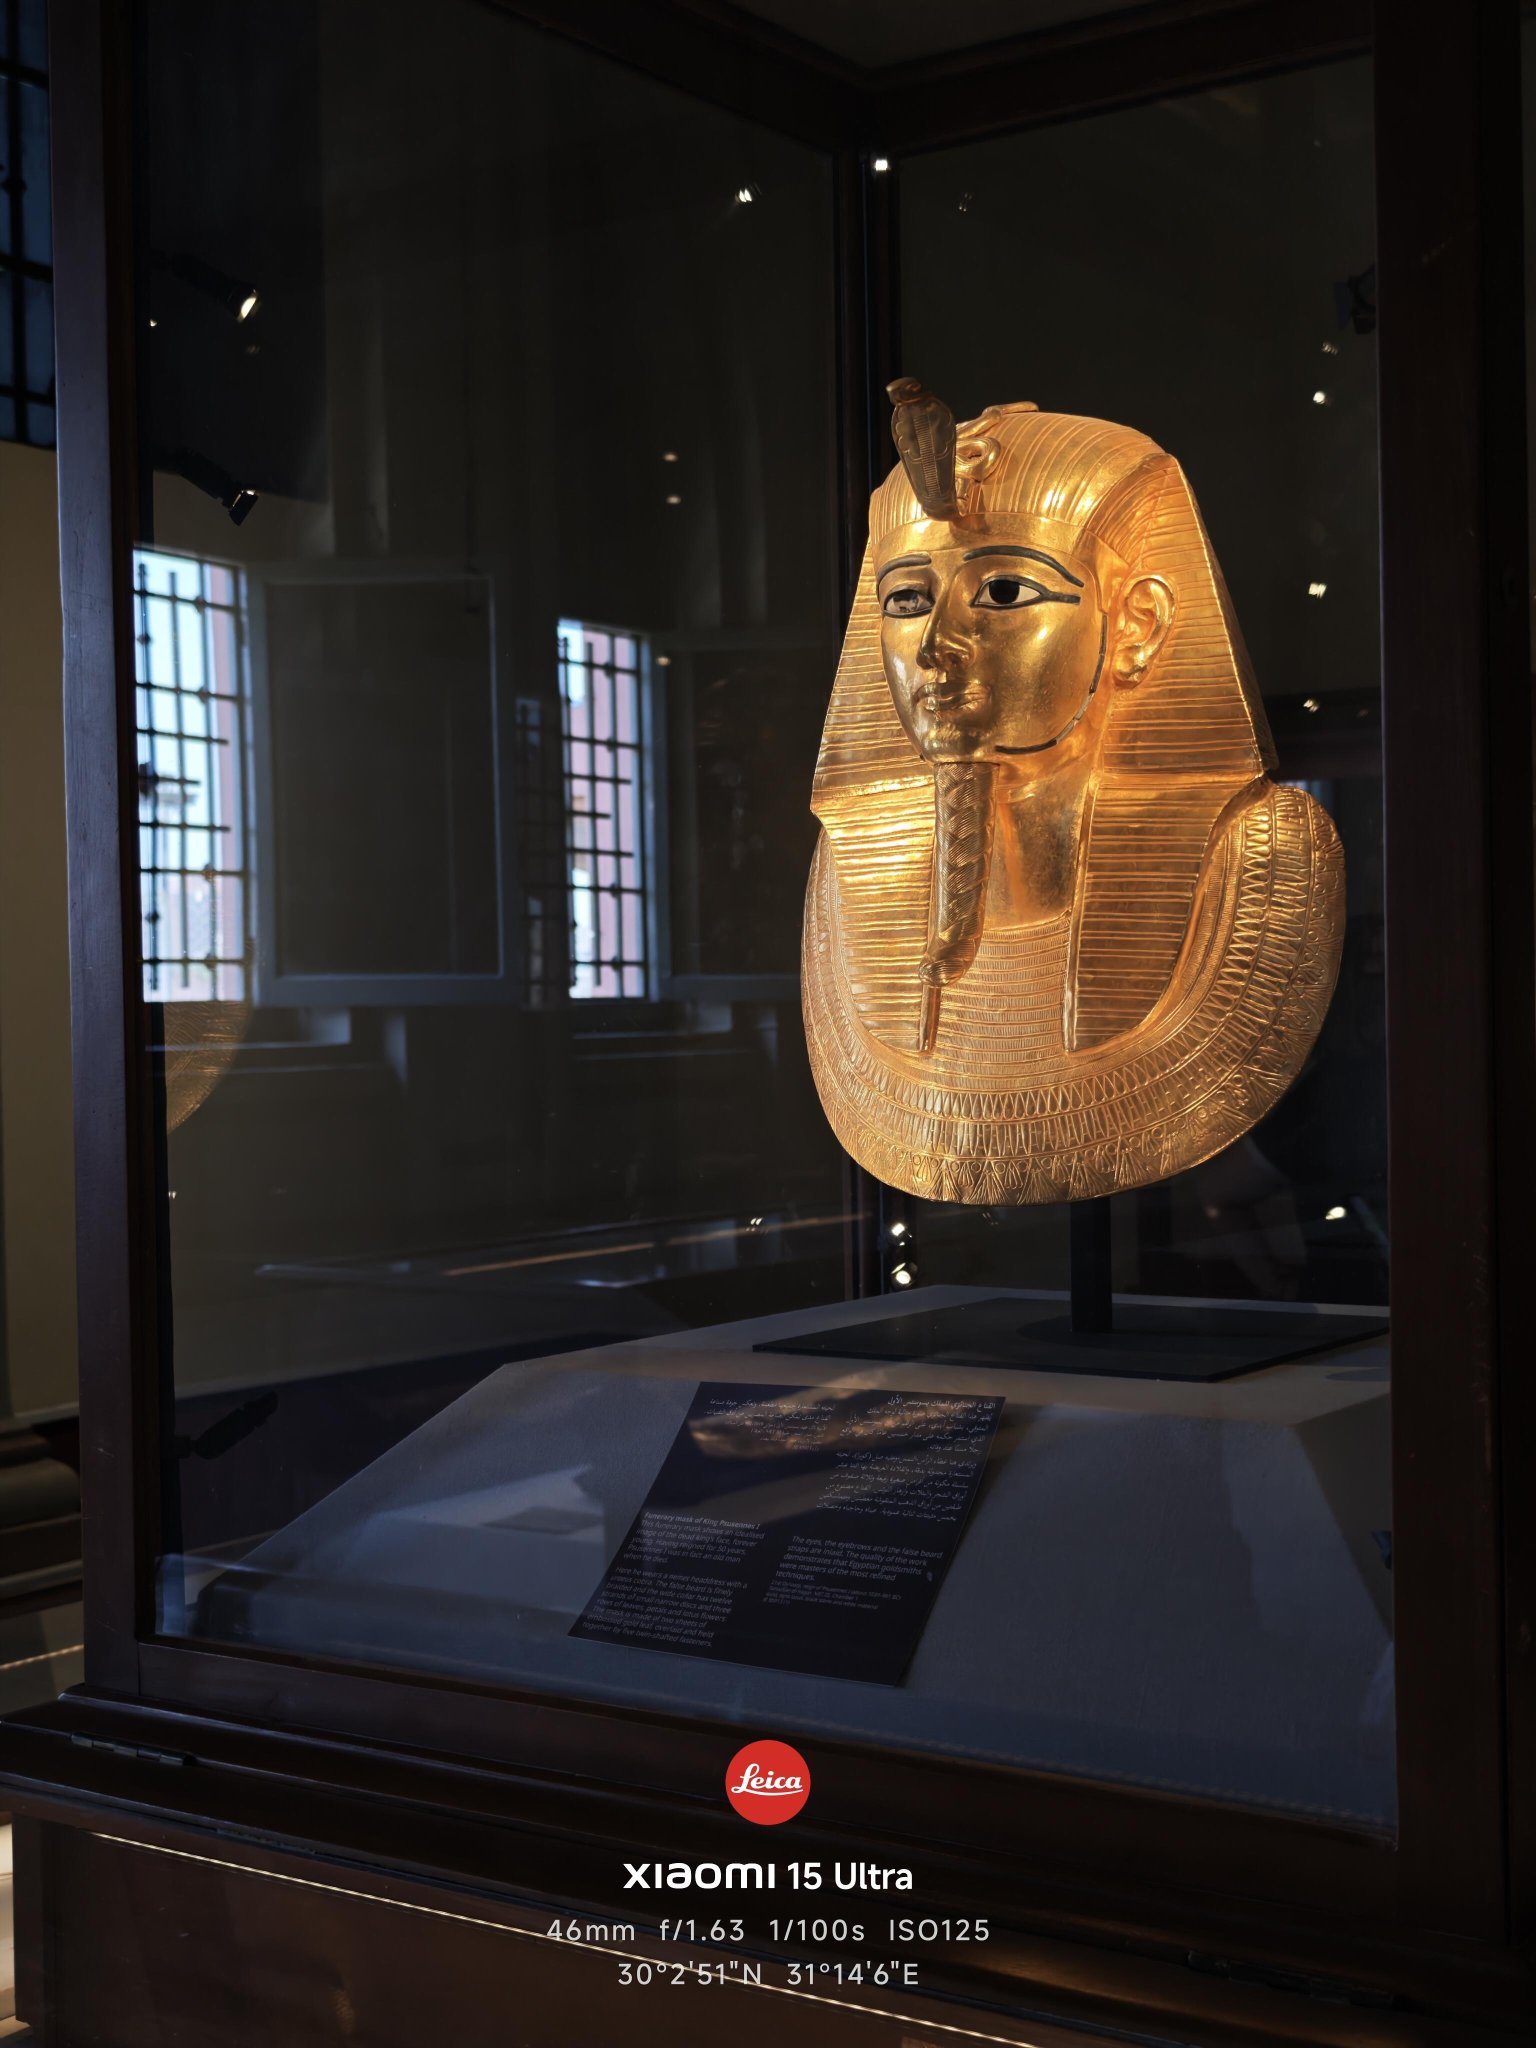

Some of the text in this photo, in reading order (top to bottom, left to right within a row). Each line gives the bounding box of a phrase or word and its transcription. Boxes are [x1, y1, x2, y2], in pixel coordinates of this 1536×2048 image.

[645, 1513, 675, 1522] Funerary
[703, 1519, 719, 1527] King
[720, 1520, 757, 1529] Psusennes
[656, 1522, 683, 1531] funerary
[636, 1529, 657, 1537] image
[733, 1539, 758, 1547] forever
[656, 1540, 679, 1549] Having
[680, 1542, 706, 1552] reigned
[788, 1545, 810, 1554] straps
[861, 1553, 885, 1563] quality
[909, 1558, 928, 1566] work
[839, 1541, 872, 1552] eyebrows
[921, 1550, 944, 1558] beard
[784, 1554, 923, 1577] demonstrates that Egyptian goldsmiths
[799, 1564, 827, 1573] masters
[850, 1570, 869, 1578] most
[870, 1572, 897, 1581] refined
[615, 1567, 632, 1575] Here
[726, 1581, 742, 1589] with
[776, 1571, 817, 1583] techniques.
[659, 1590, 676, 1598] wide
[677, 1592, 695, 1600] collar
[669, 1582, 686, 1590] false
[686, 1585, 706, 1593] beard
[636, 1595, 654, 1603] small
[655, 1599, 680, 1607] narrow
[713, 1606, 732, 1614] three
[606, 1608, 625, 1617] mask
[632, 1612, 653, 1621] made
[675, 1618, 700, 1627] sheets
[683, 1611, 700, 1619] lotus
[698, 1631, 714, 1639] held
